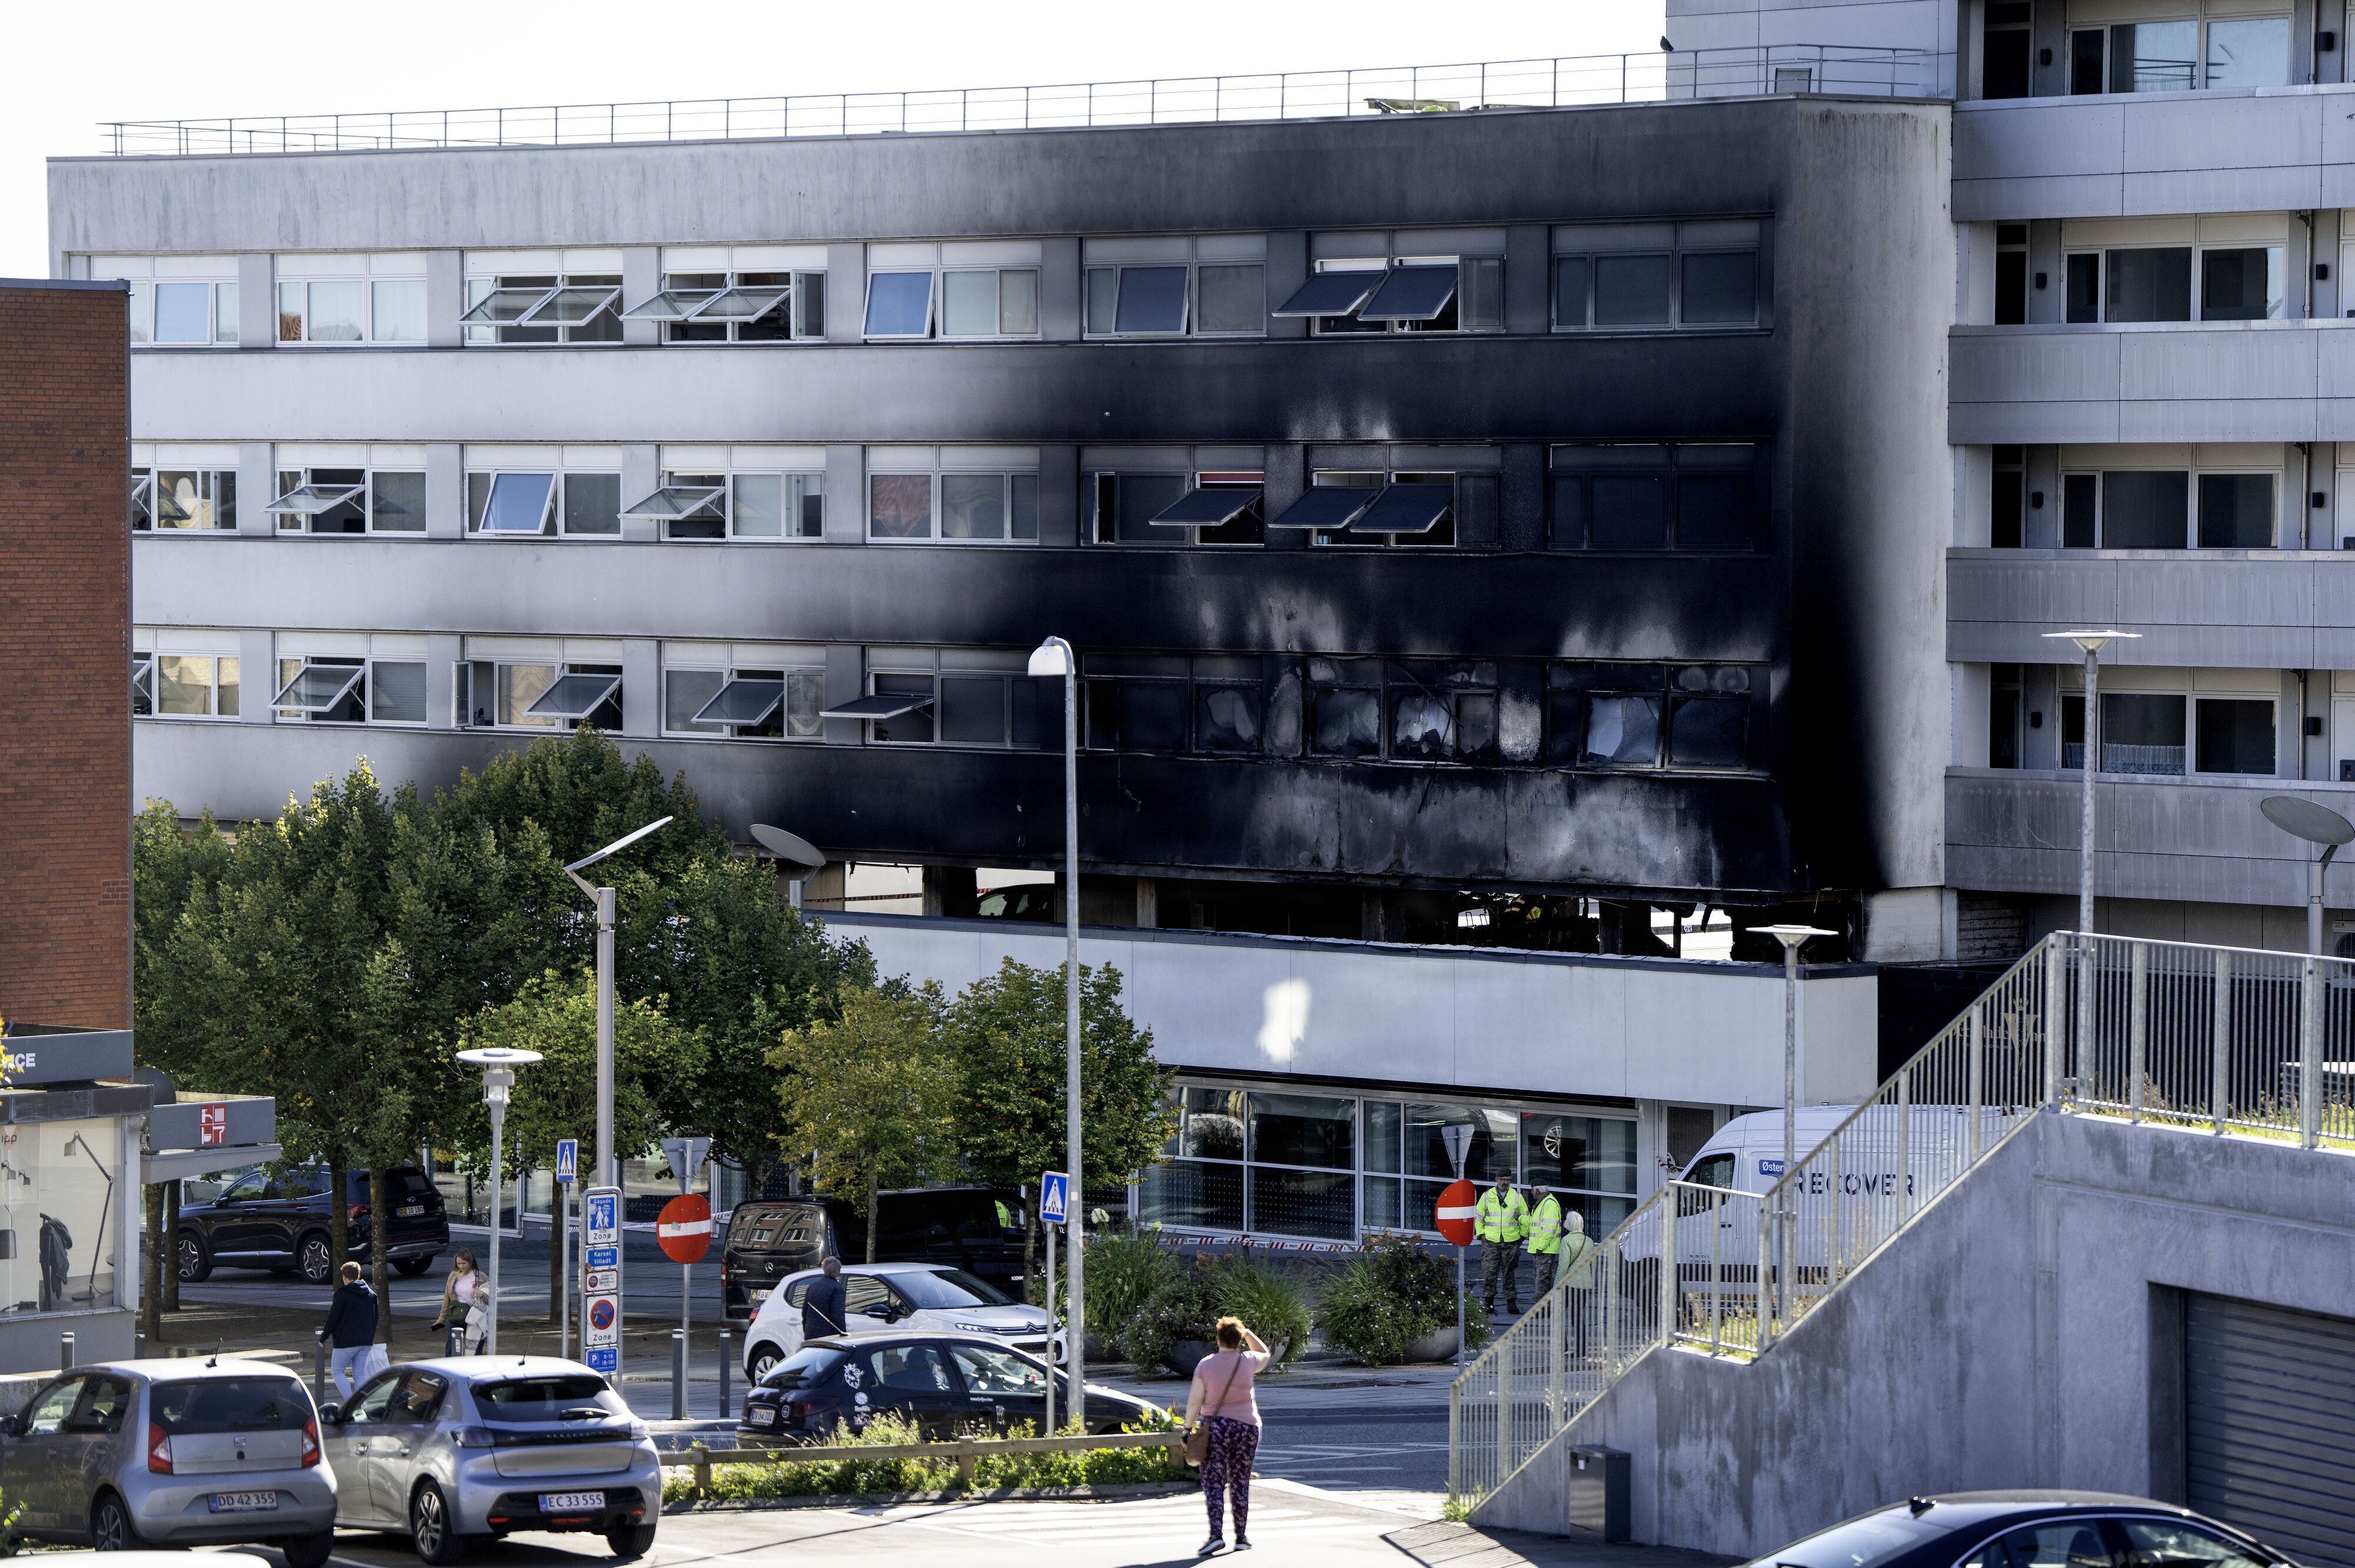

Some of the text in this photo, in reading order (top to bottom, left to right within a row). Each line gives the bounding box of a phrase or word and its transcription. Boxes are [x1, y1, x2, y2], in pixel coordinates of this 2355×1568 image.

[1762, 1161, 1785, 1172] Øster
[752, 1410, 773, 1421] DV 64 301
[218, 1493, 275, 1506] DD 42 355
[548, 1494, 602, 1507] EC 33 555
